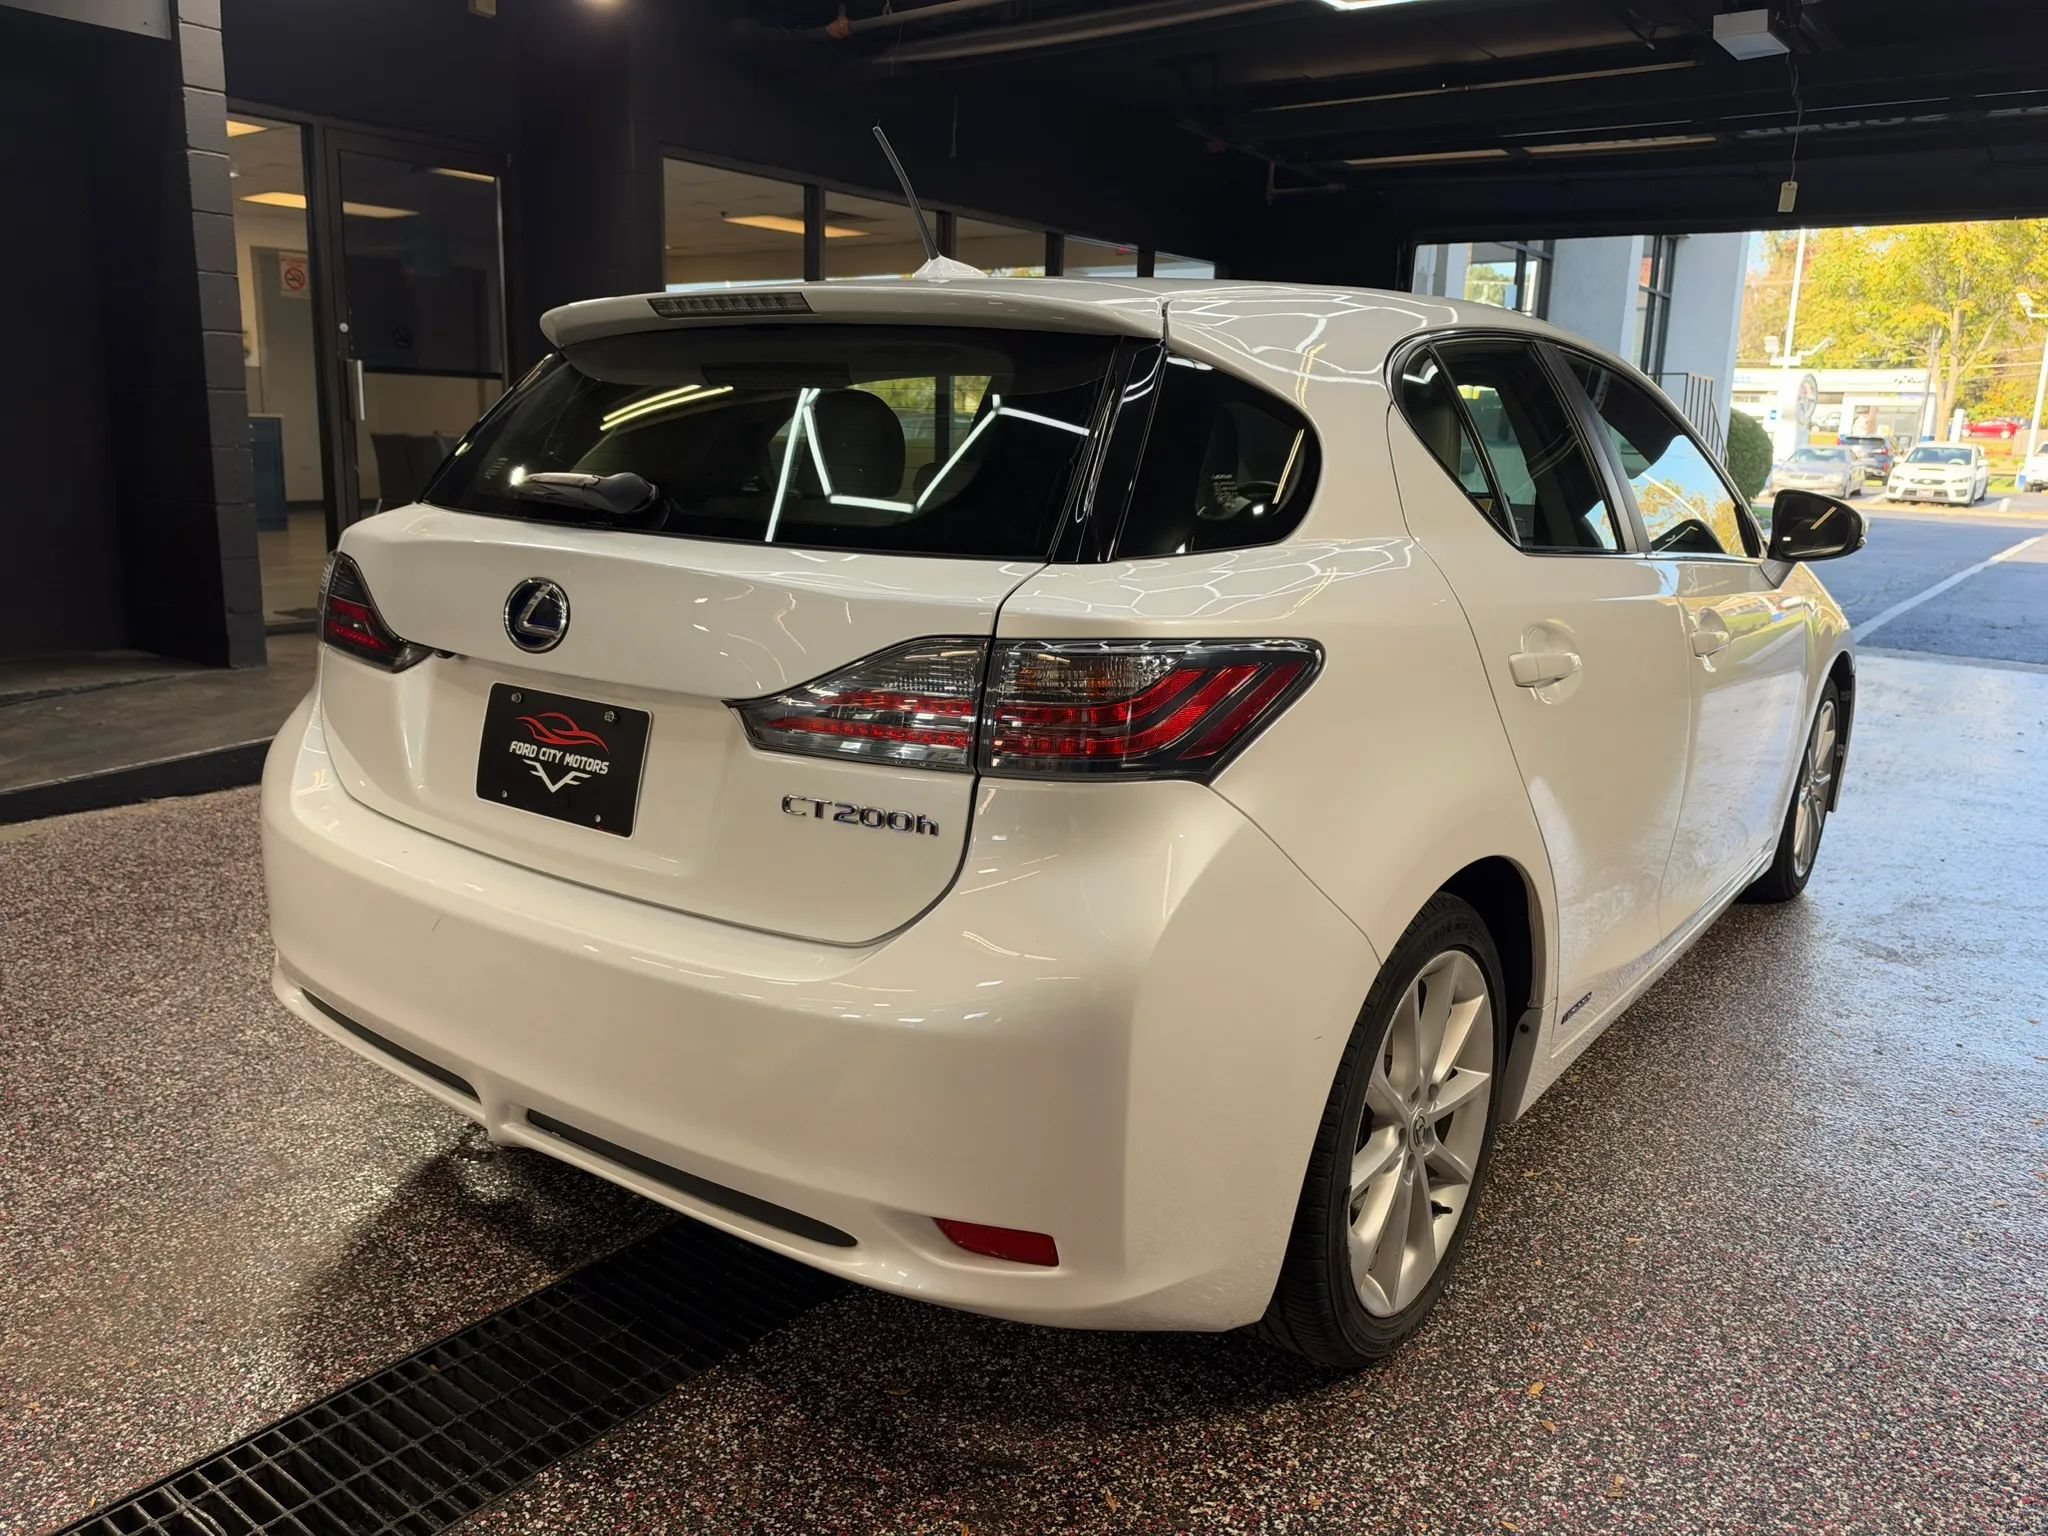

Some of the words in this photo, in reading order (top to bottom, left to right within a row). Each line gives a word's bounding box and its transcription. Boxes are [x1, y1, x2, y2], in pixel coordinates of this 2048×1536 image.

[509, 740, 538, 758] FORD
[539, 747, 563, 763] CITY
[564, 752, 610, 775] MOTORS
[781, 794, 940, 837] CT200h
